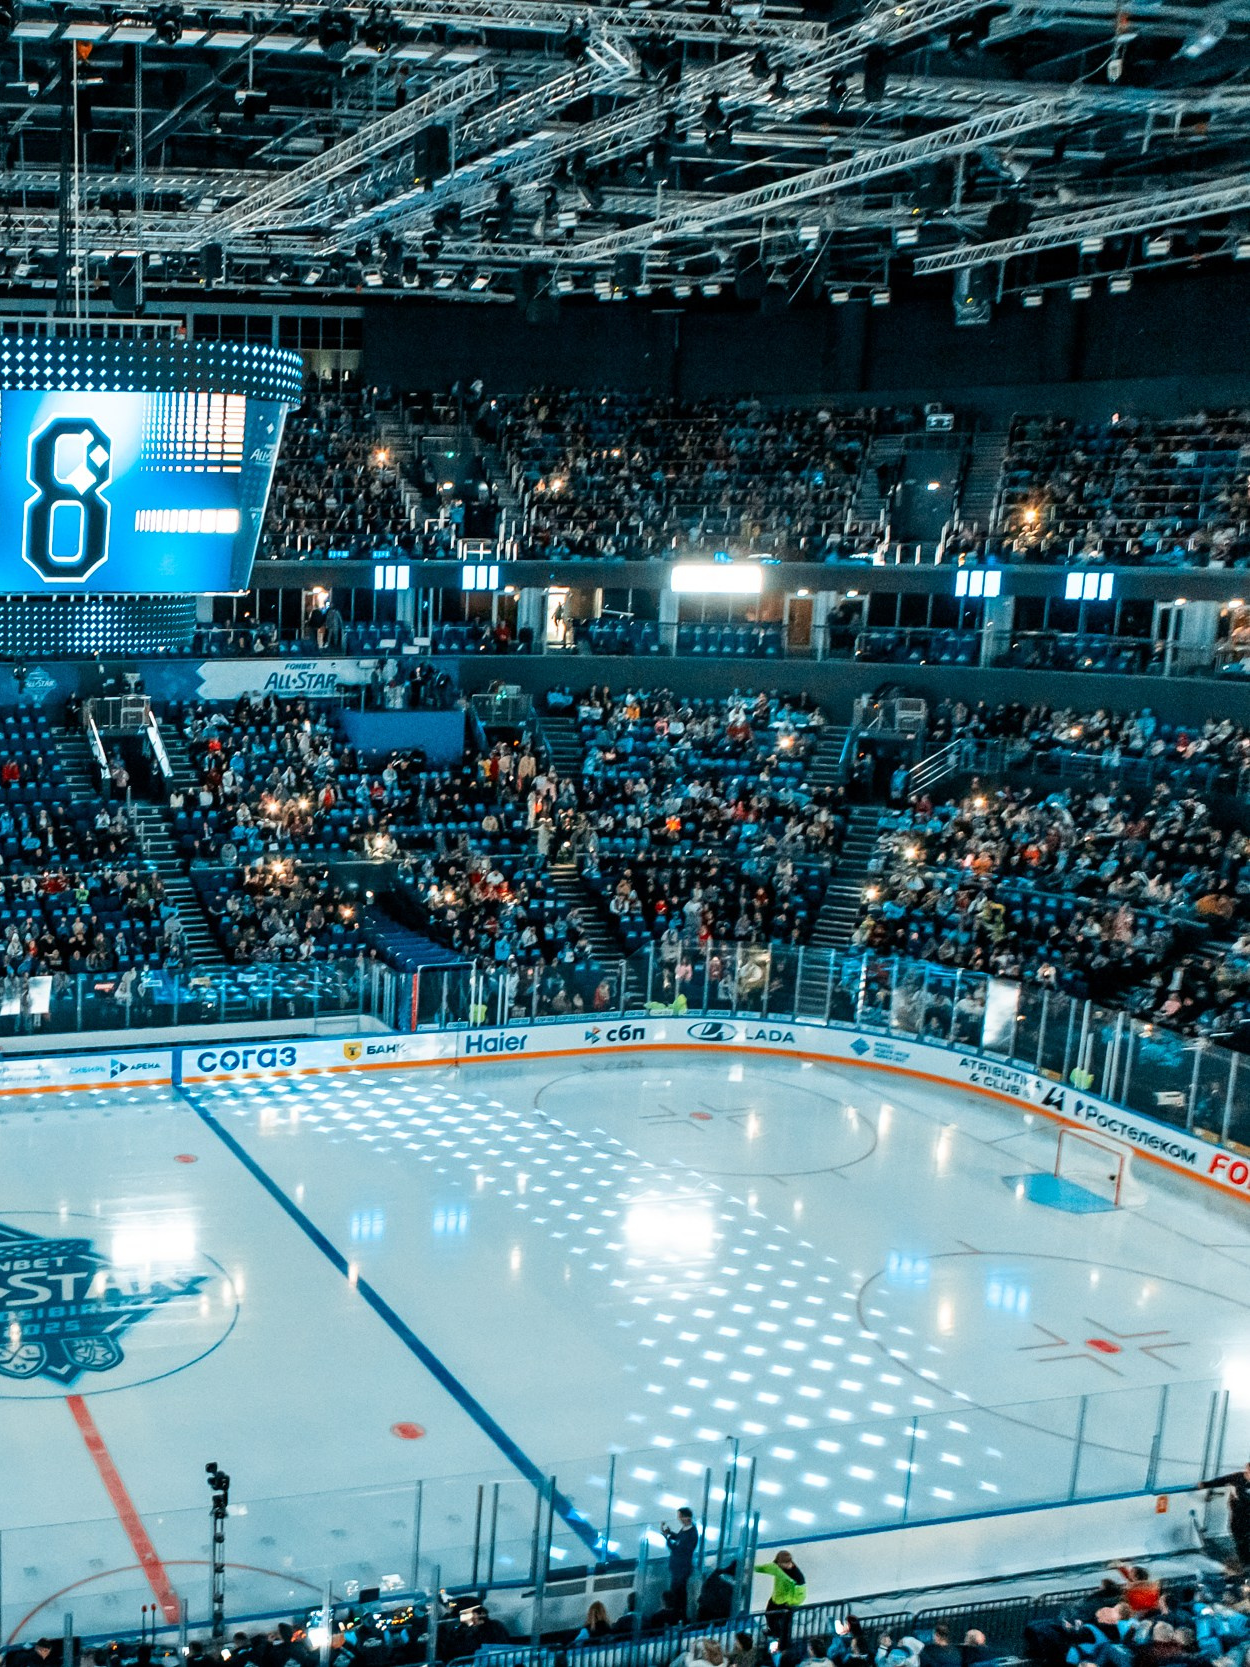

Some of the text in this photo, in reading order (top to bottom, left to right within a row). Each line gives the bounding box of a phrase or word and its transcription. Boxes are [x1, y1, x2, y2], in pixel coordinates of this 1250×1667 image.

[22, 412, 113, 583] 8
[285, 662, 317, 670] FONBET
[606, 1025, 645, 1041] сбп
[745, 1028, 795, 1043] LADA
[466, 1032, 528, 1054] Haier
[131, 1062, 161, 1070] АРЕНА
[983, 1076, 1020, 1095] CLUB
[1086, 1104, 1198, 1165] Ростелеком
